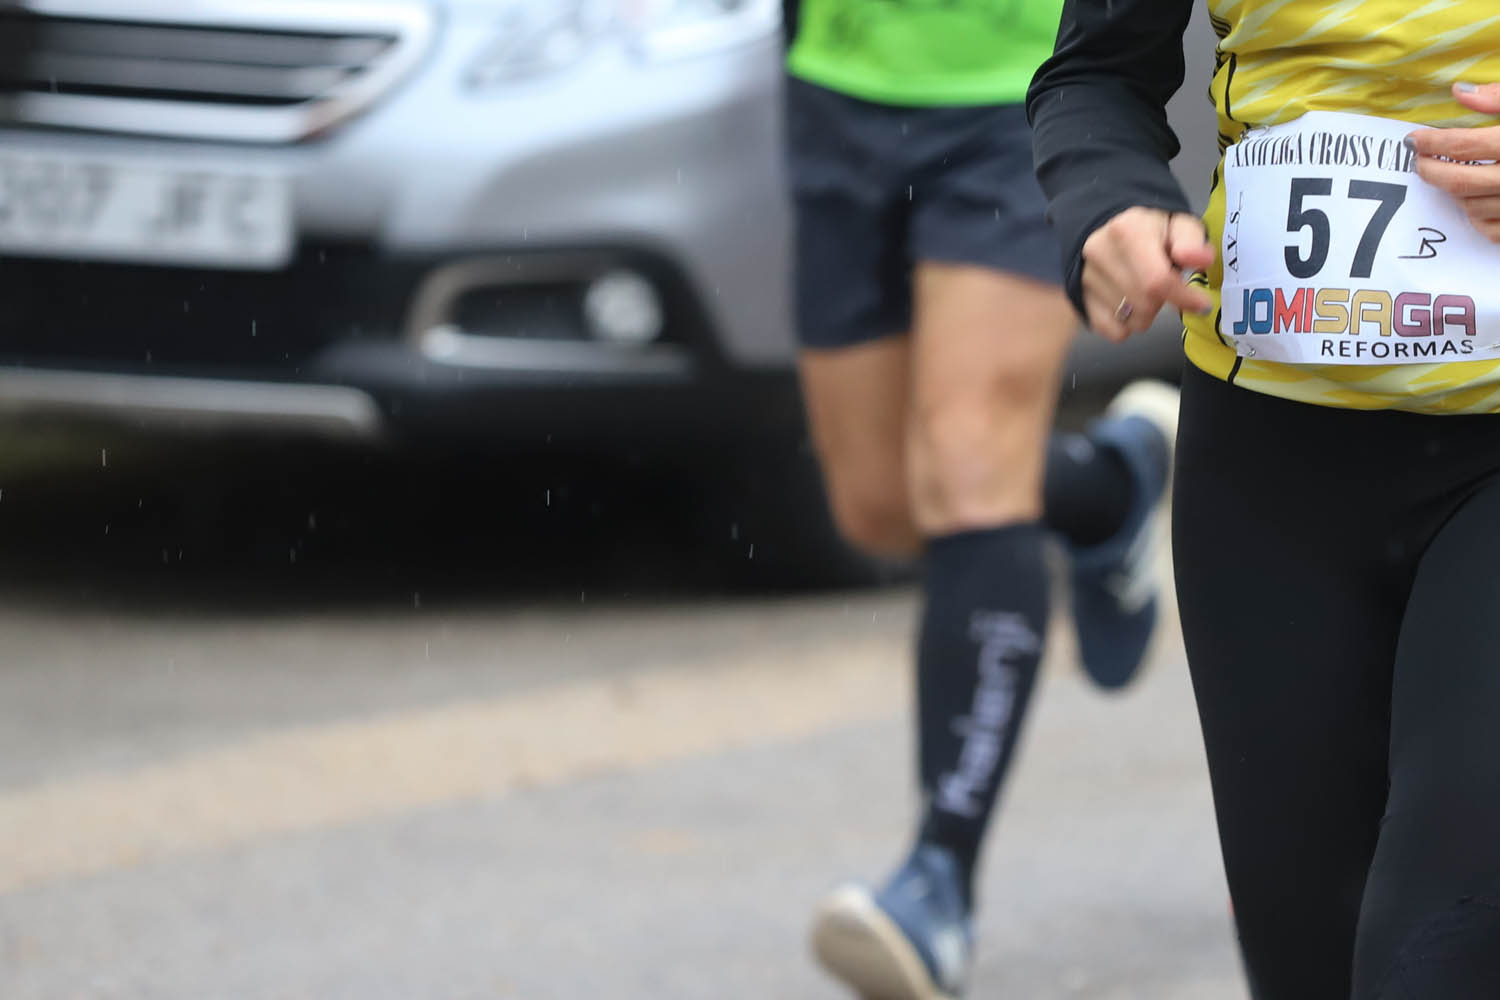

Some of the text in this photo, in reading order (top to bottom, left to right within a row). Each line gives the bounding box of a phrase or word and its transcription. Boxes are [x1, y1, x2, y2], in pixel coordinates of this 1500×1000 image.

[1309, 131, 1374, 168] CROSS
[1283, 177, 1408, 279] 57
[1233, 287, 1477, 337] JOMISAGA
[1320, 339, 1474, 358] REFORMAS
